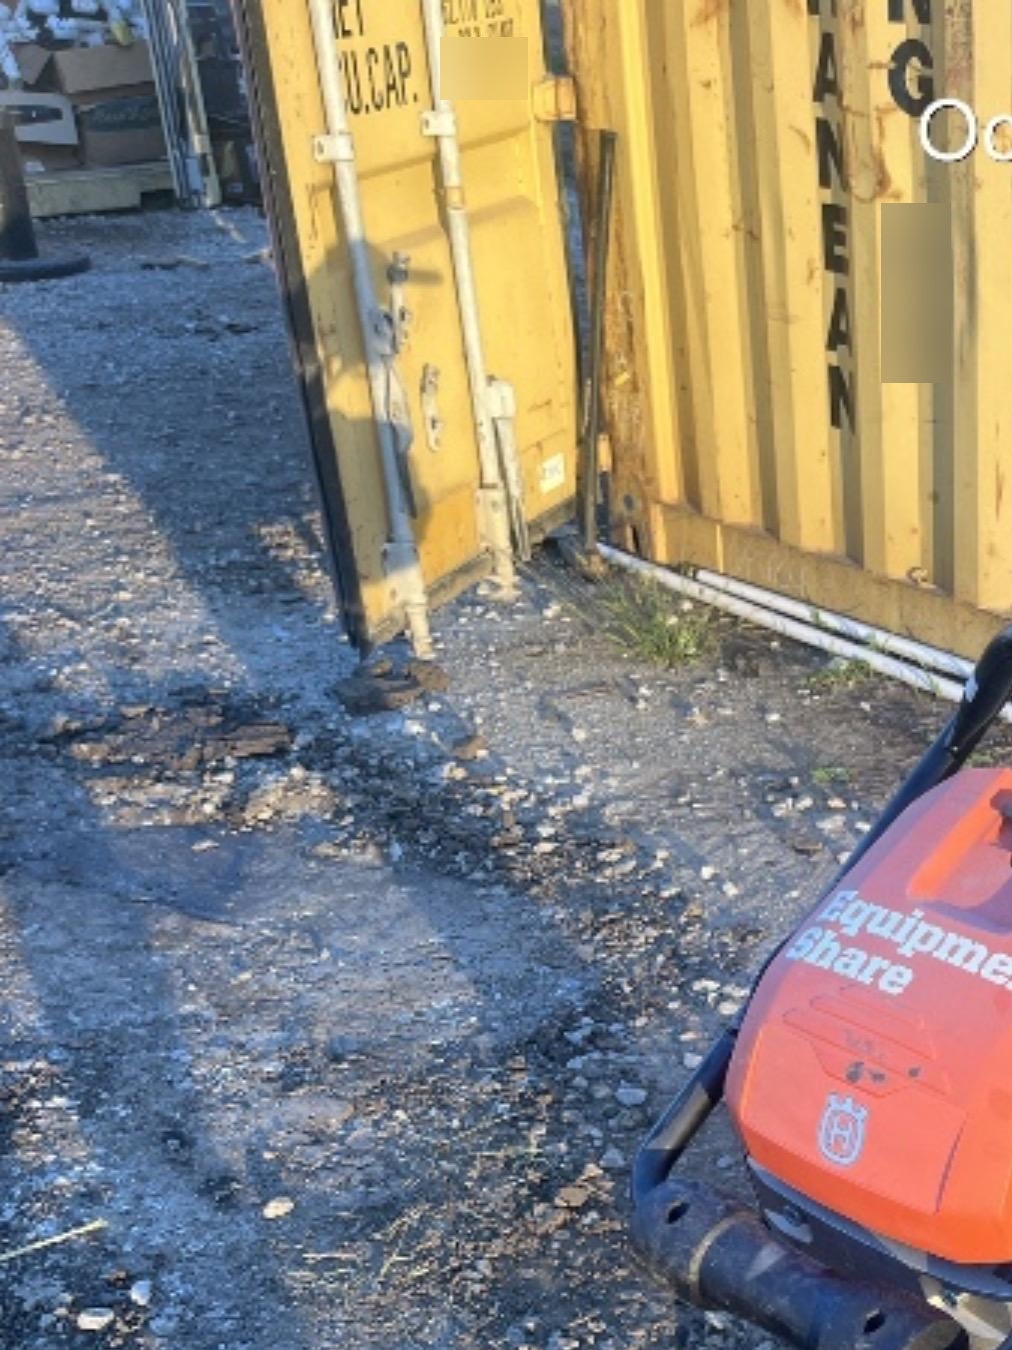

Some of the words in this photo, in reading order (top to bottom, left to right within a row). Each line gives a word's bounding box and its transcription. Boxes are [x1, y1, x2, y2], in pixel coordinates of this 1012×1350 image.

[338, 41, 417, 115] U.CAP.
[807, 0, 857, 434] ANEAN
[785, 926, 914, 996] Share
